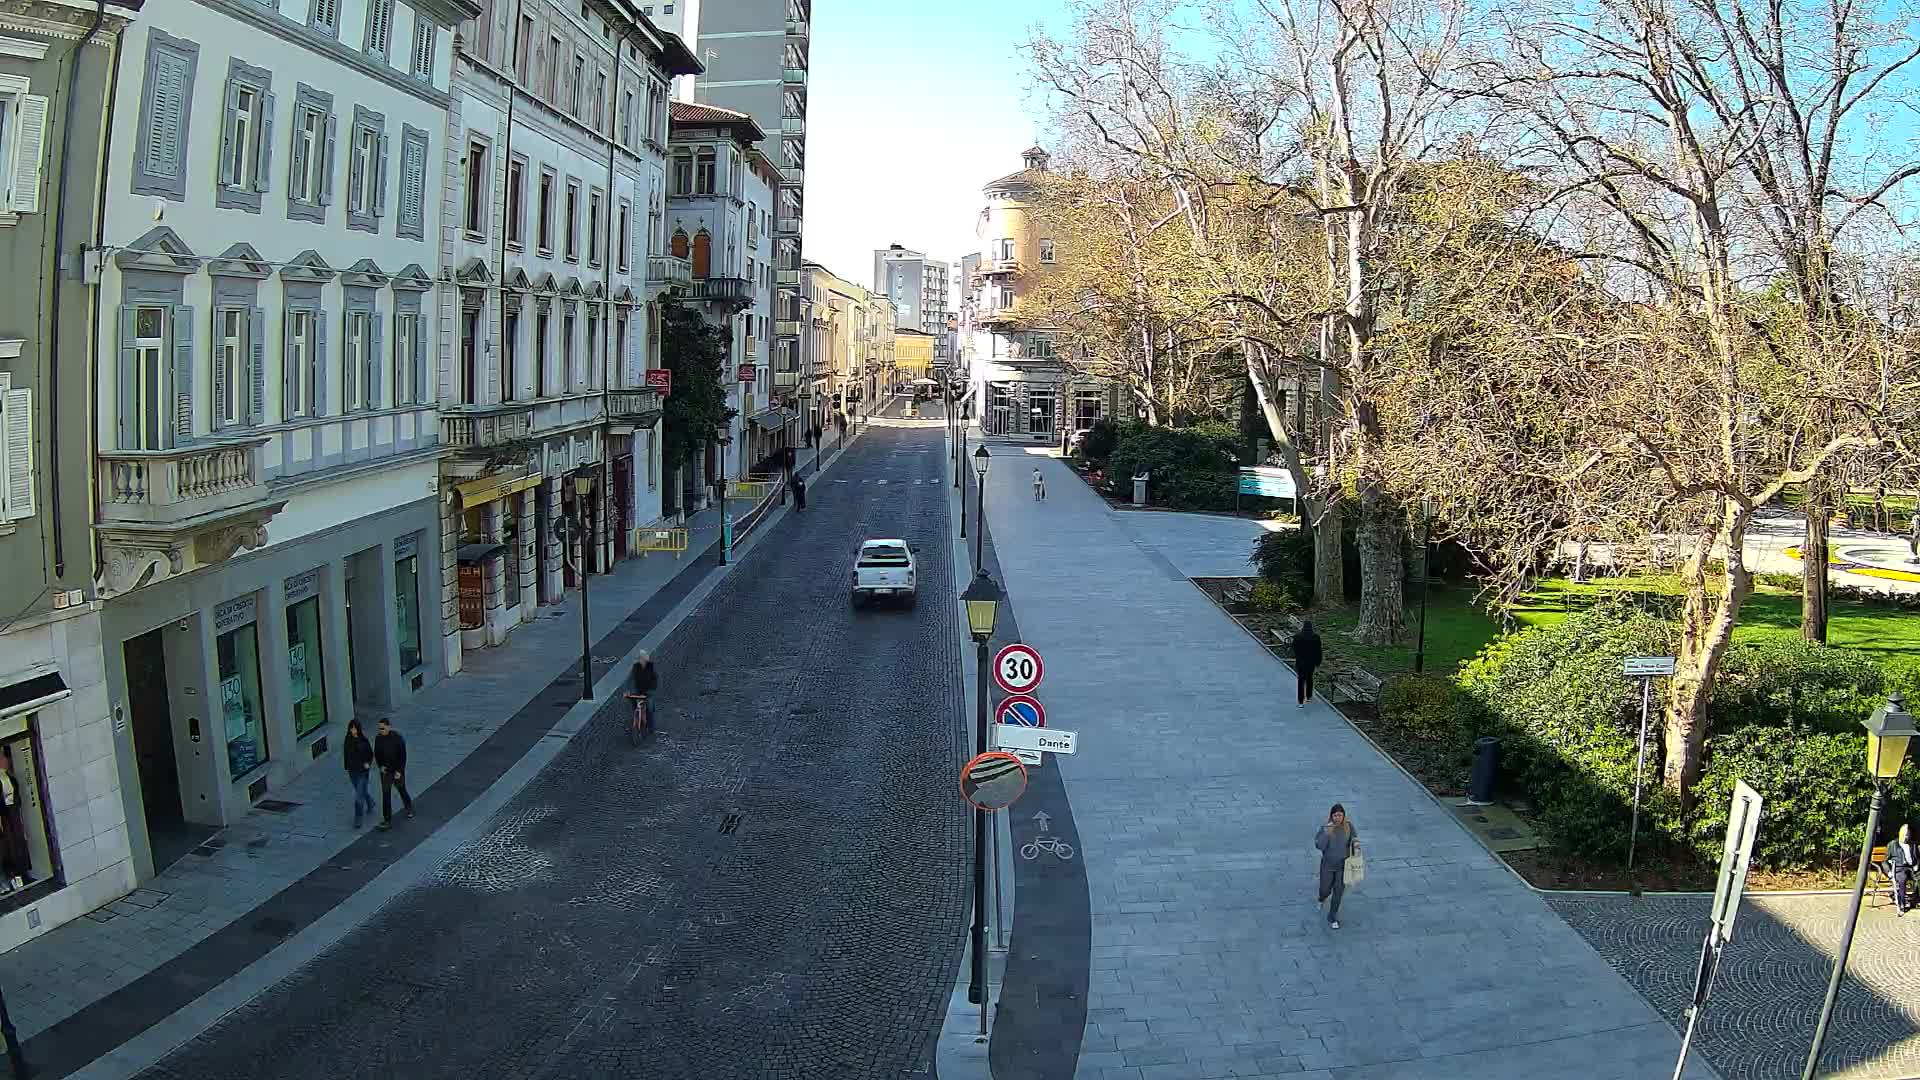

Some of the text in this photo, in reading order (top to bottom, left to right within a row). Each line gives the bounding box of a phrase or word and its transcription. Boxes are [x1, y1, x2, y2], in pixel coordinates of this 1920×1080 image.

[1006, 658, 1032, 679] 30
[222, 678, 241, 702] 130
[1039, 738, 1070, 749] Dante
